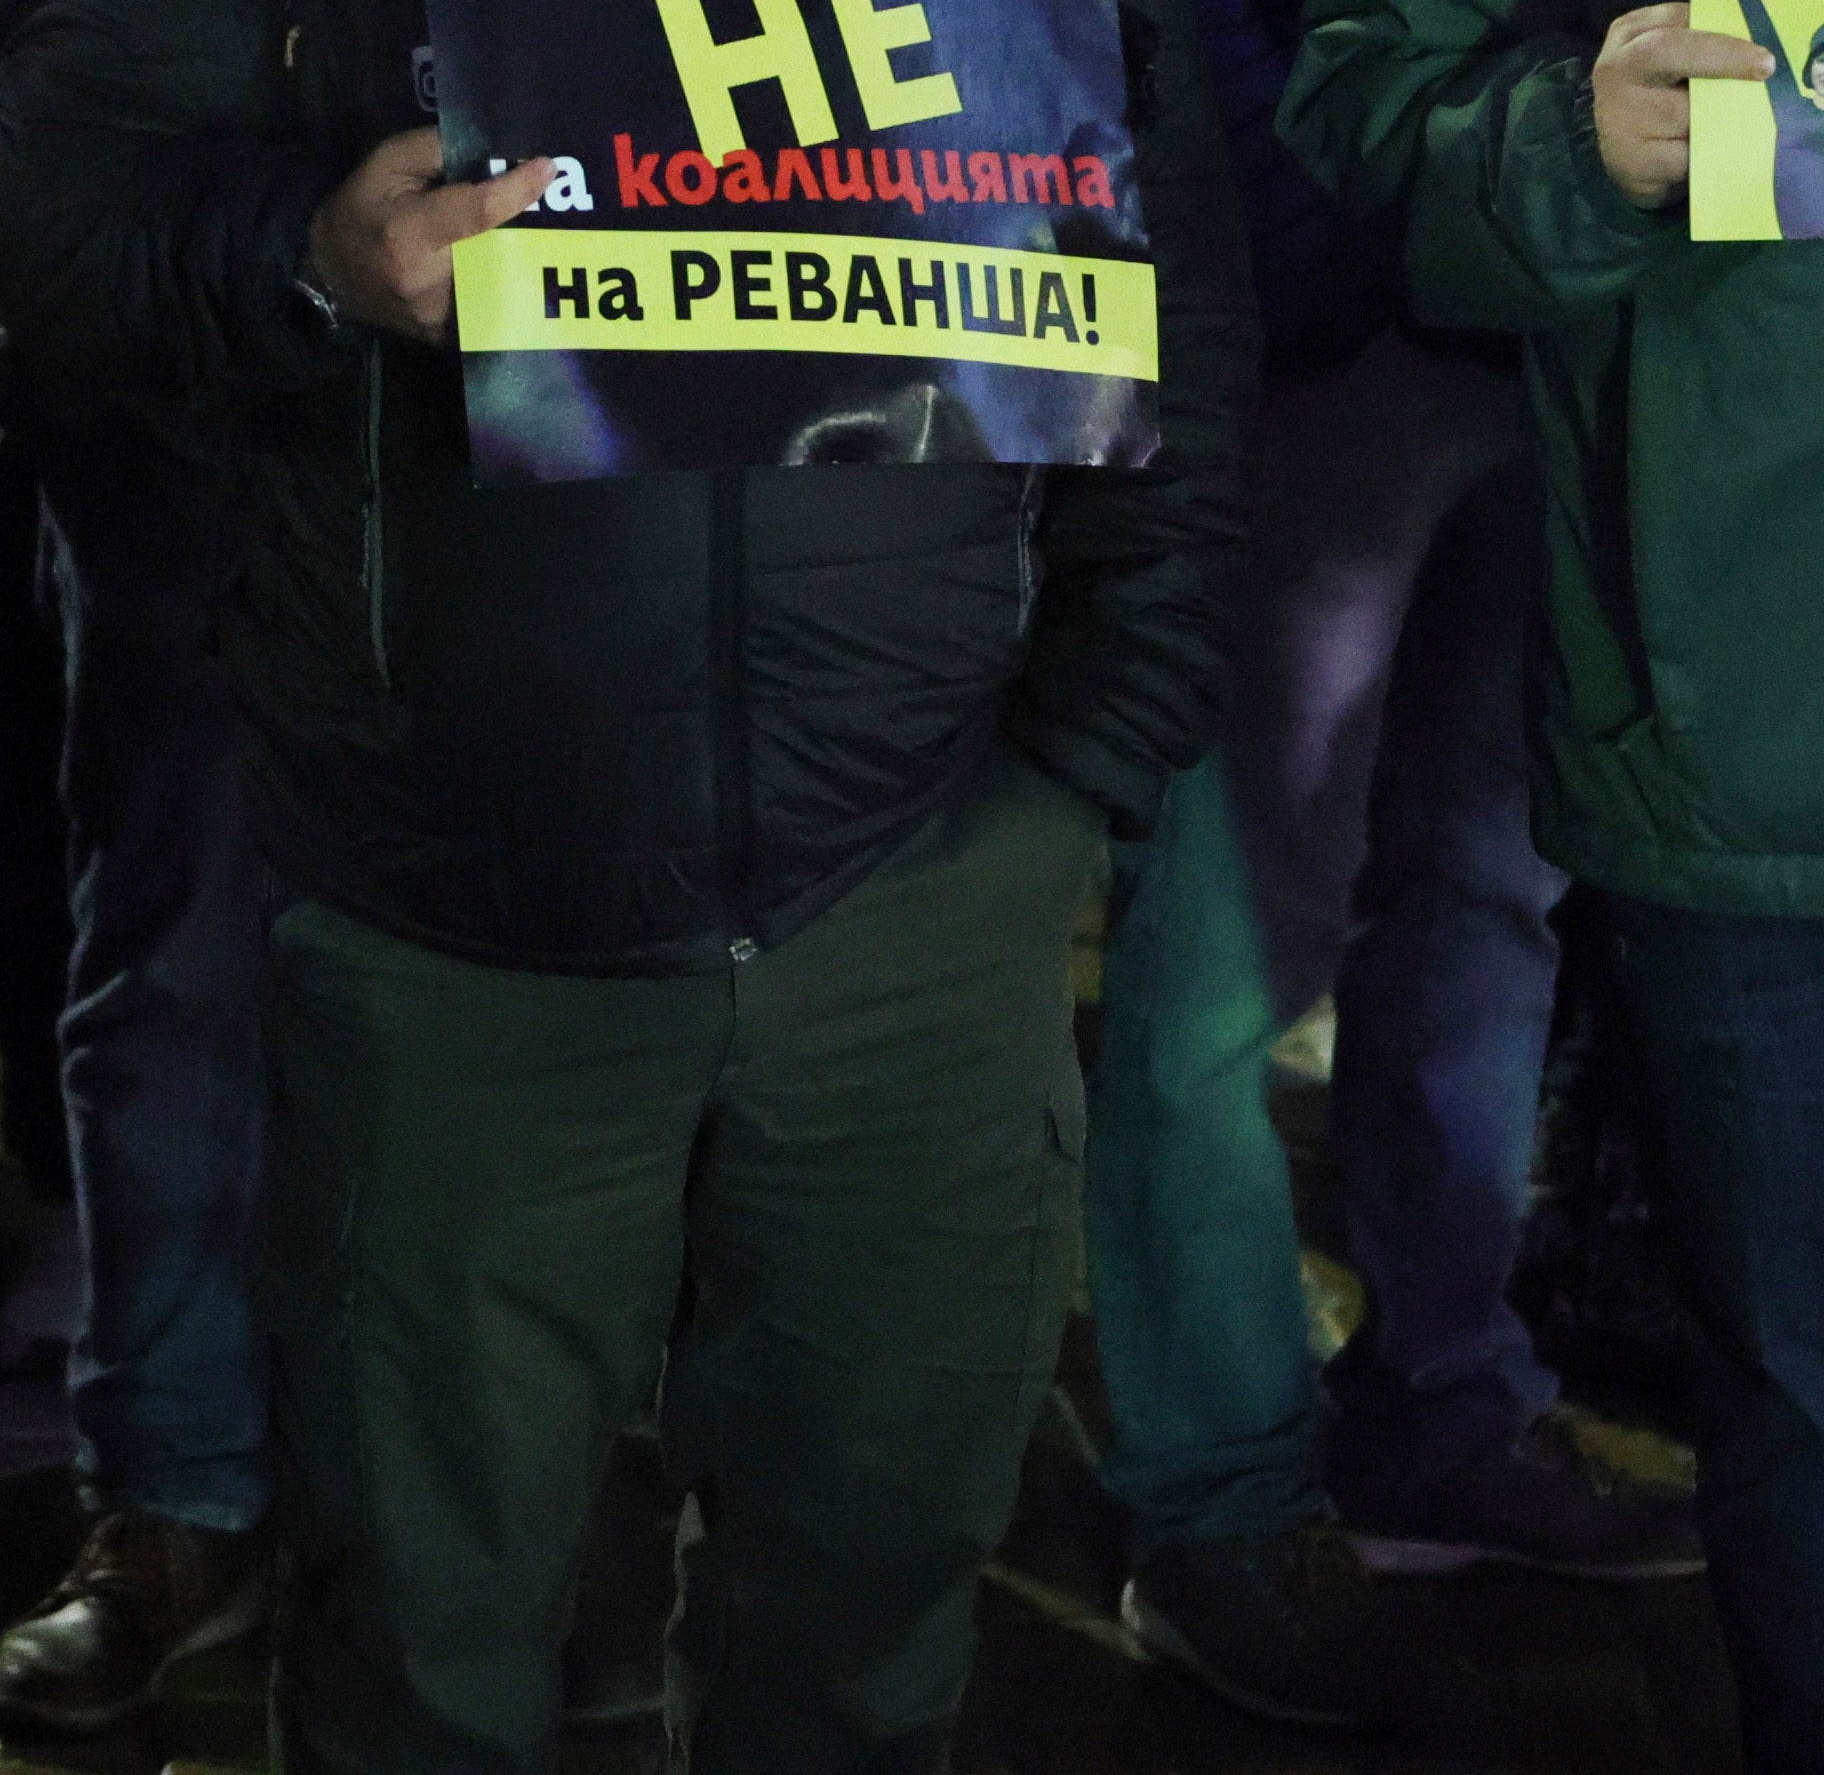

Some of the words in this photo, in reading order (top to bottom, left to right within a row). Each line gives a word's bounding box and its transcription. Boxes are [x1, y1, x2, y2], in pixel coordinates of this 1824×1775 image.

[489, 155, 594, 212] а
[613, 133, 1114, 214] коалицията
[543, 265, 644, 322] на
[672, 250, 1100, 345] РЕВАНША!
